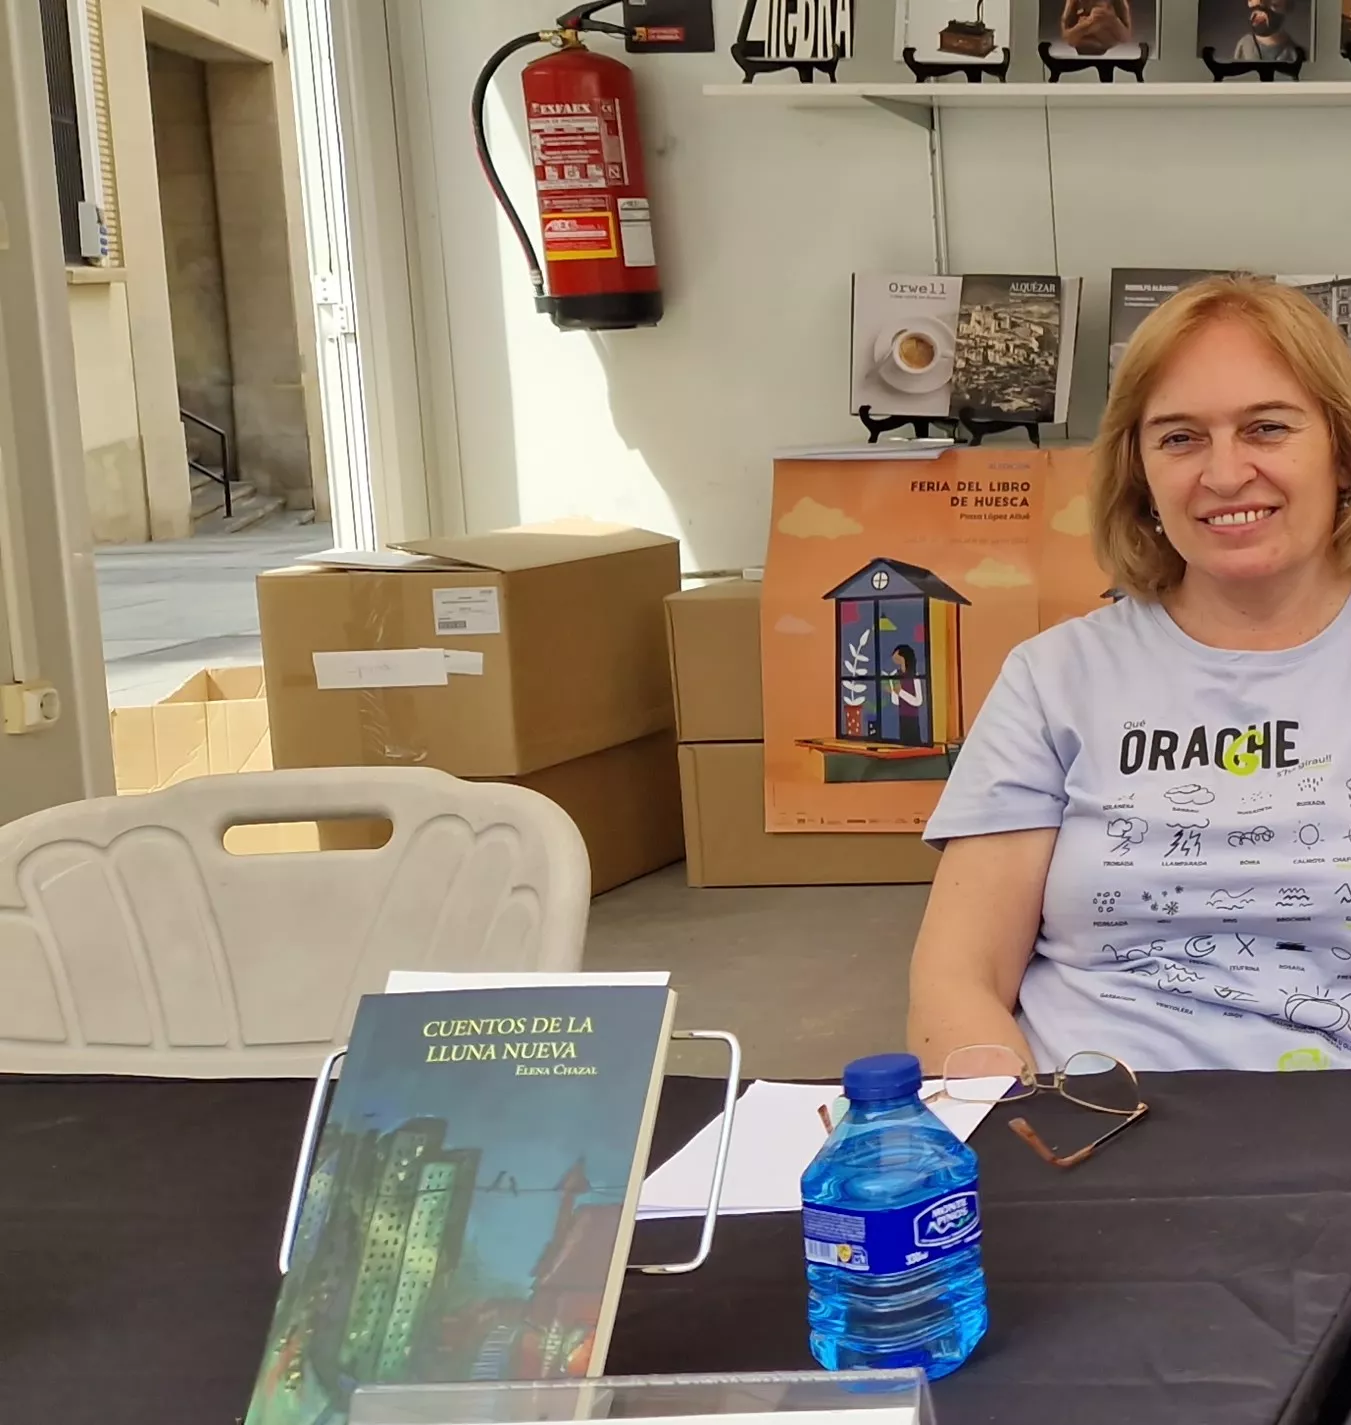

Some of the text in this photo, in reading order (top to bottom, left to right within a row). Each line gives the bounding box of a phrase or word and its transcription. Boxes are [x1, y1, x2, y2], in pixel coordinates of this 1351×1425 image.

[888, 282, 947, 295] Orwell
[1009, 281, 1056, 293] ALQUÉZAR
[910, 481, 1031, 492] FERIA DEL LIBRO
[950, 496, 1029, 507] DE HUESCA
[423, 1016, 593, 1038] CUENTOS DE LA
[425, 1041, 577, 1063] LLUNA NUEVA
